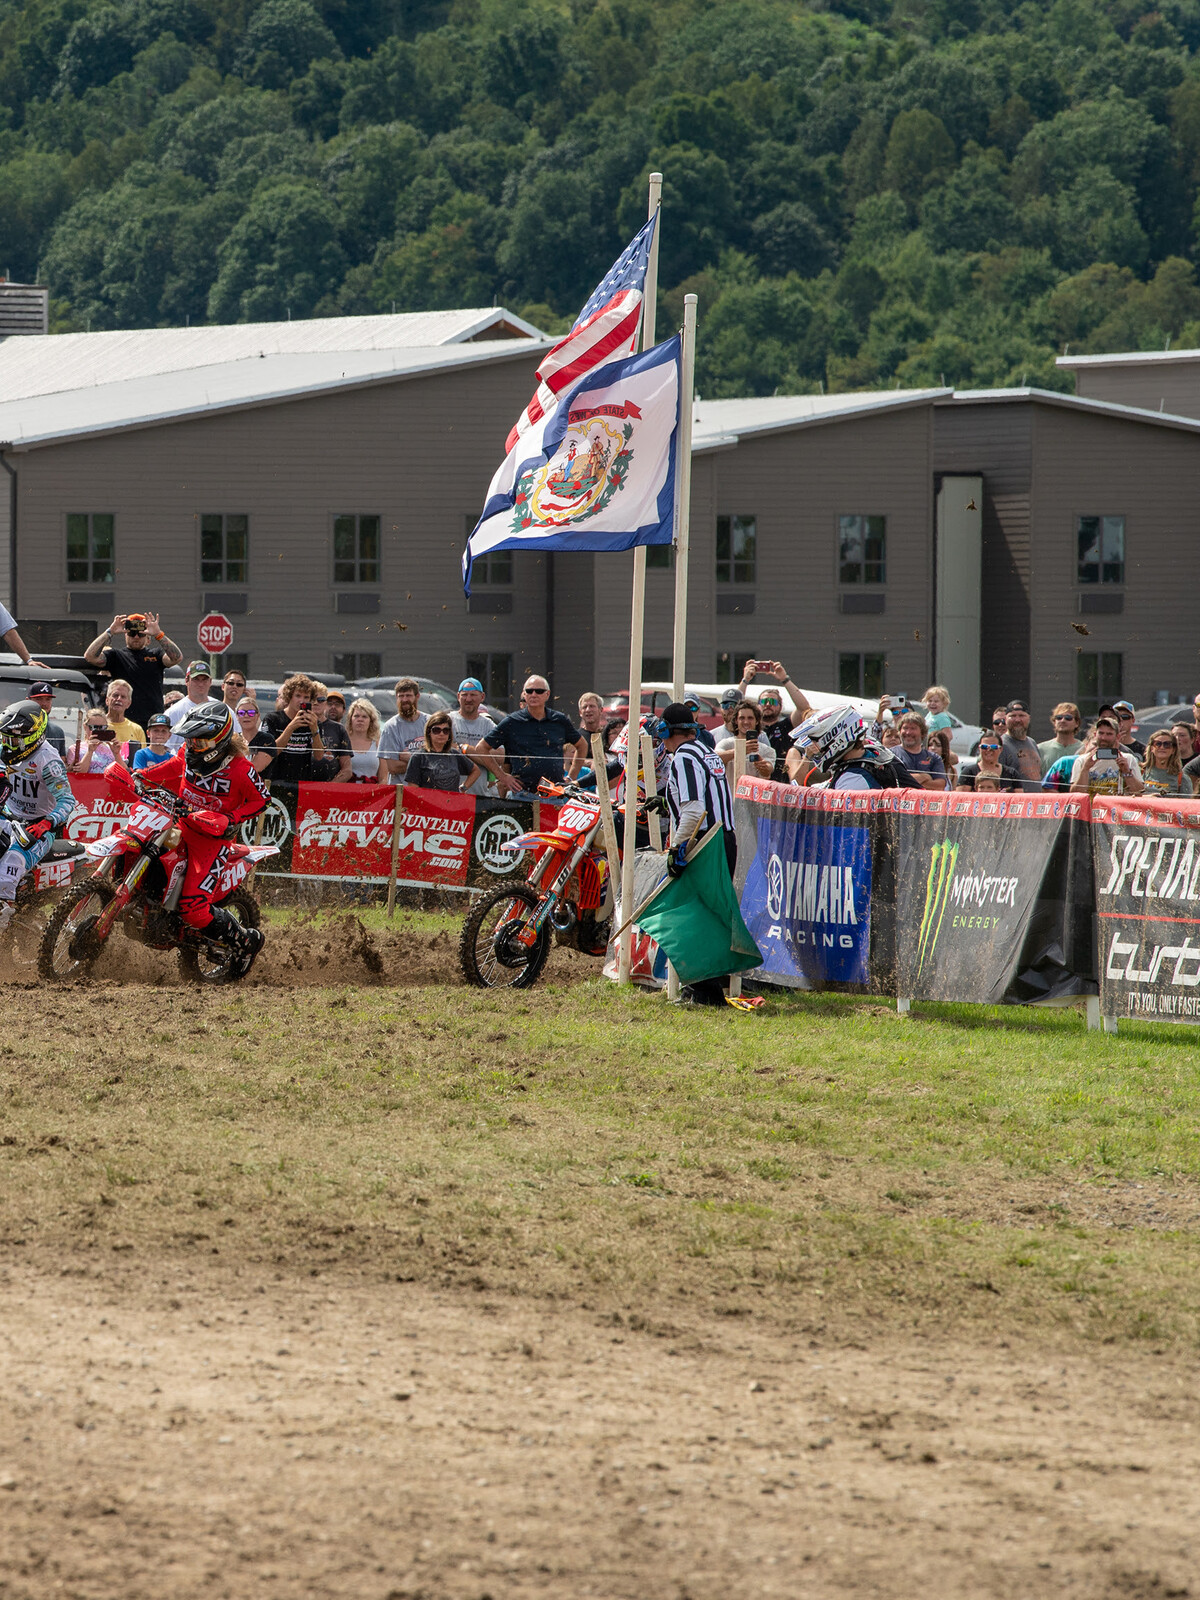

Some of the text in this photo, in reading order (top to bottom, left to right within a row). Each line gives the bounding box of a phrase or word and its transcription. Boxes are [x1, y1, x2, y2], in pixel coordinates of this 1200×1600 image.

[200, 626, 231, 642] STOP
[820, 720, 848, 747] 100%
[13, 773, 41, 799] FLY
[93, 798, 134, 816] ROCK
[127, 804, 171, 831] 314
[326, 807, 378, 825] ROCKY
[558, 807, 596, 832] 206
[6, 865, 19, 878] FLY
[37, 863, 72, 890] 342
[221, 862, 247, 892] 314
[785, 860, 858, 925] YAMAHA
[952, 915, 1000, 929] ENERGY
[766, 925, 854, 948] RACING
[1128, 991, 1141, 1011] IT'S
[1158, 994, 1177, 1015] ONLY
